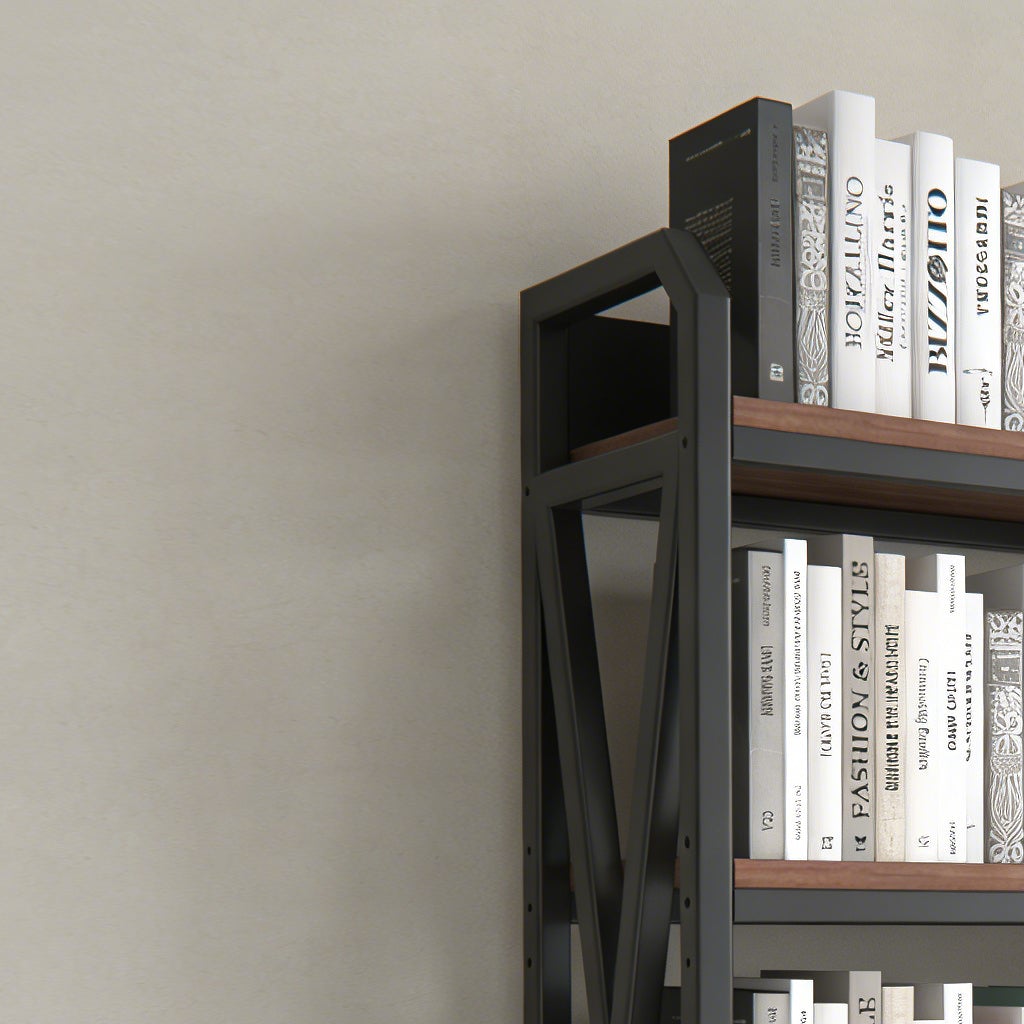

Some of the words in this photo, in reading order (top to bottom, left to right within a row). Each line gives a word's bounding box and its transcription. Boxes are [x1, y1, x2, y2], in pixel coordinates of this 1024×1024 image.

[851, 560, 870, 652] STYLE
[852, 661, 870, 682] &
[850, 688, 870, 819] FASHION
